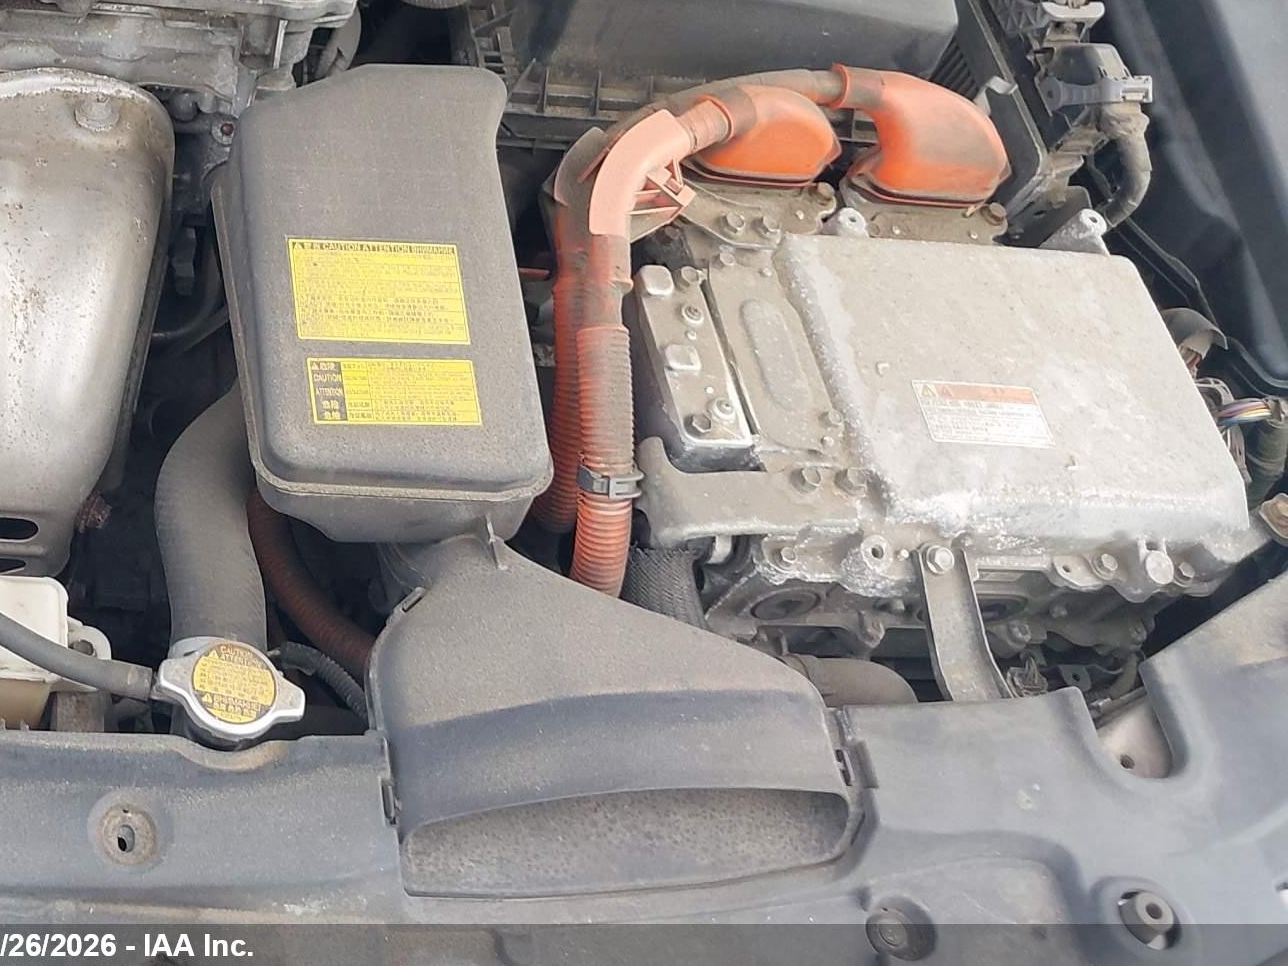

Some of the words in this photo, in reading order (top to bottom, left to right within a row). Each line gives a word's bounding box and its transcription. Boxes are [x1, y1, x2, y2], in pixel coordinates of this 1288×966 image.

[319, 242, 360, 252] CAUTION
[364, 244, 412, 254] ATTENTION
[313, 373, 342, 383] CAUTION
[316, 387, 343, 396] ATTENTION
